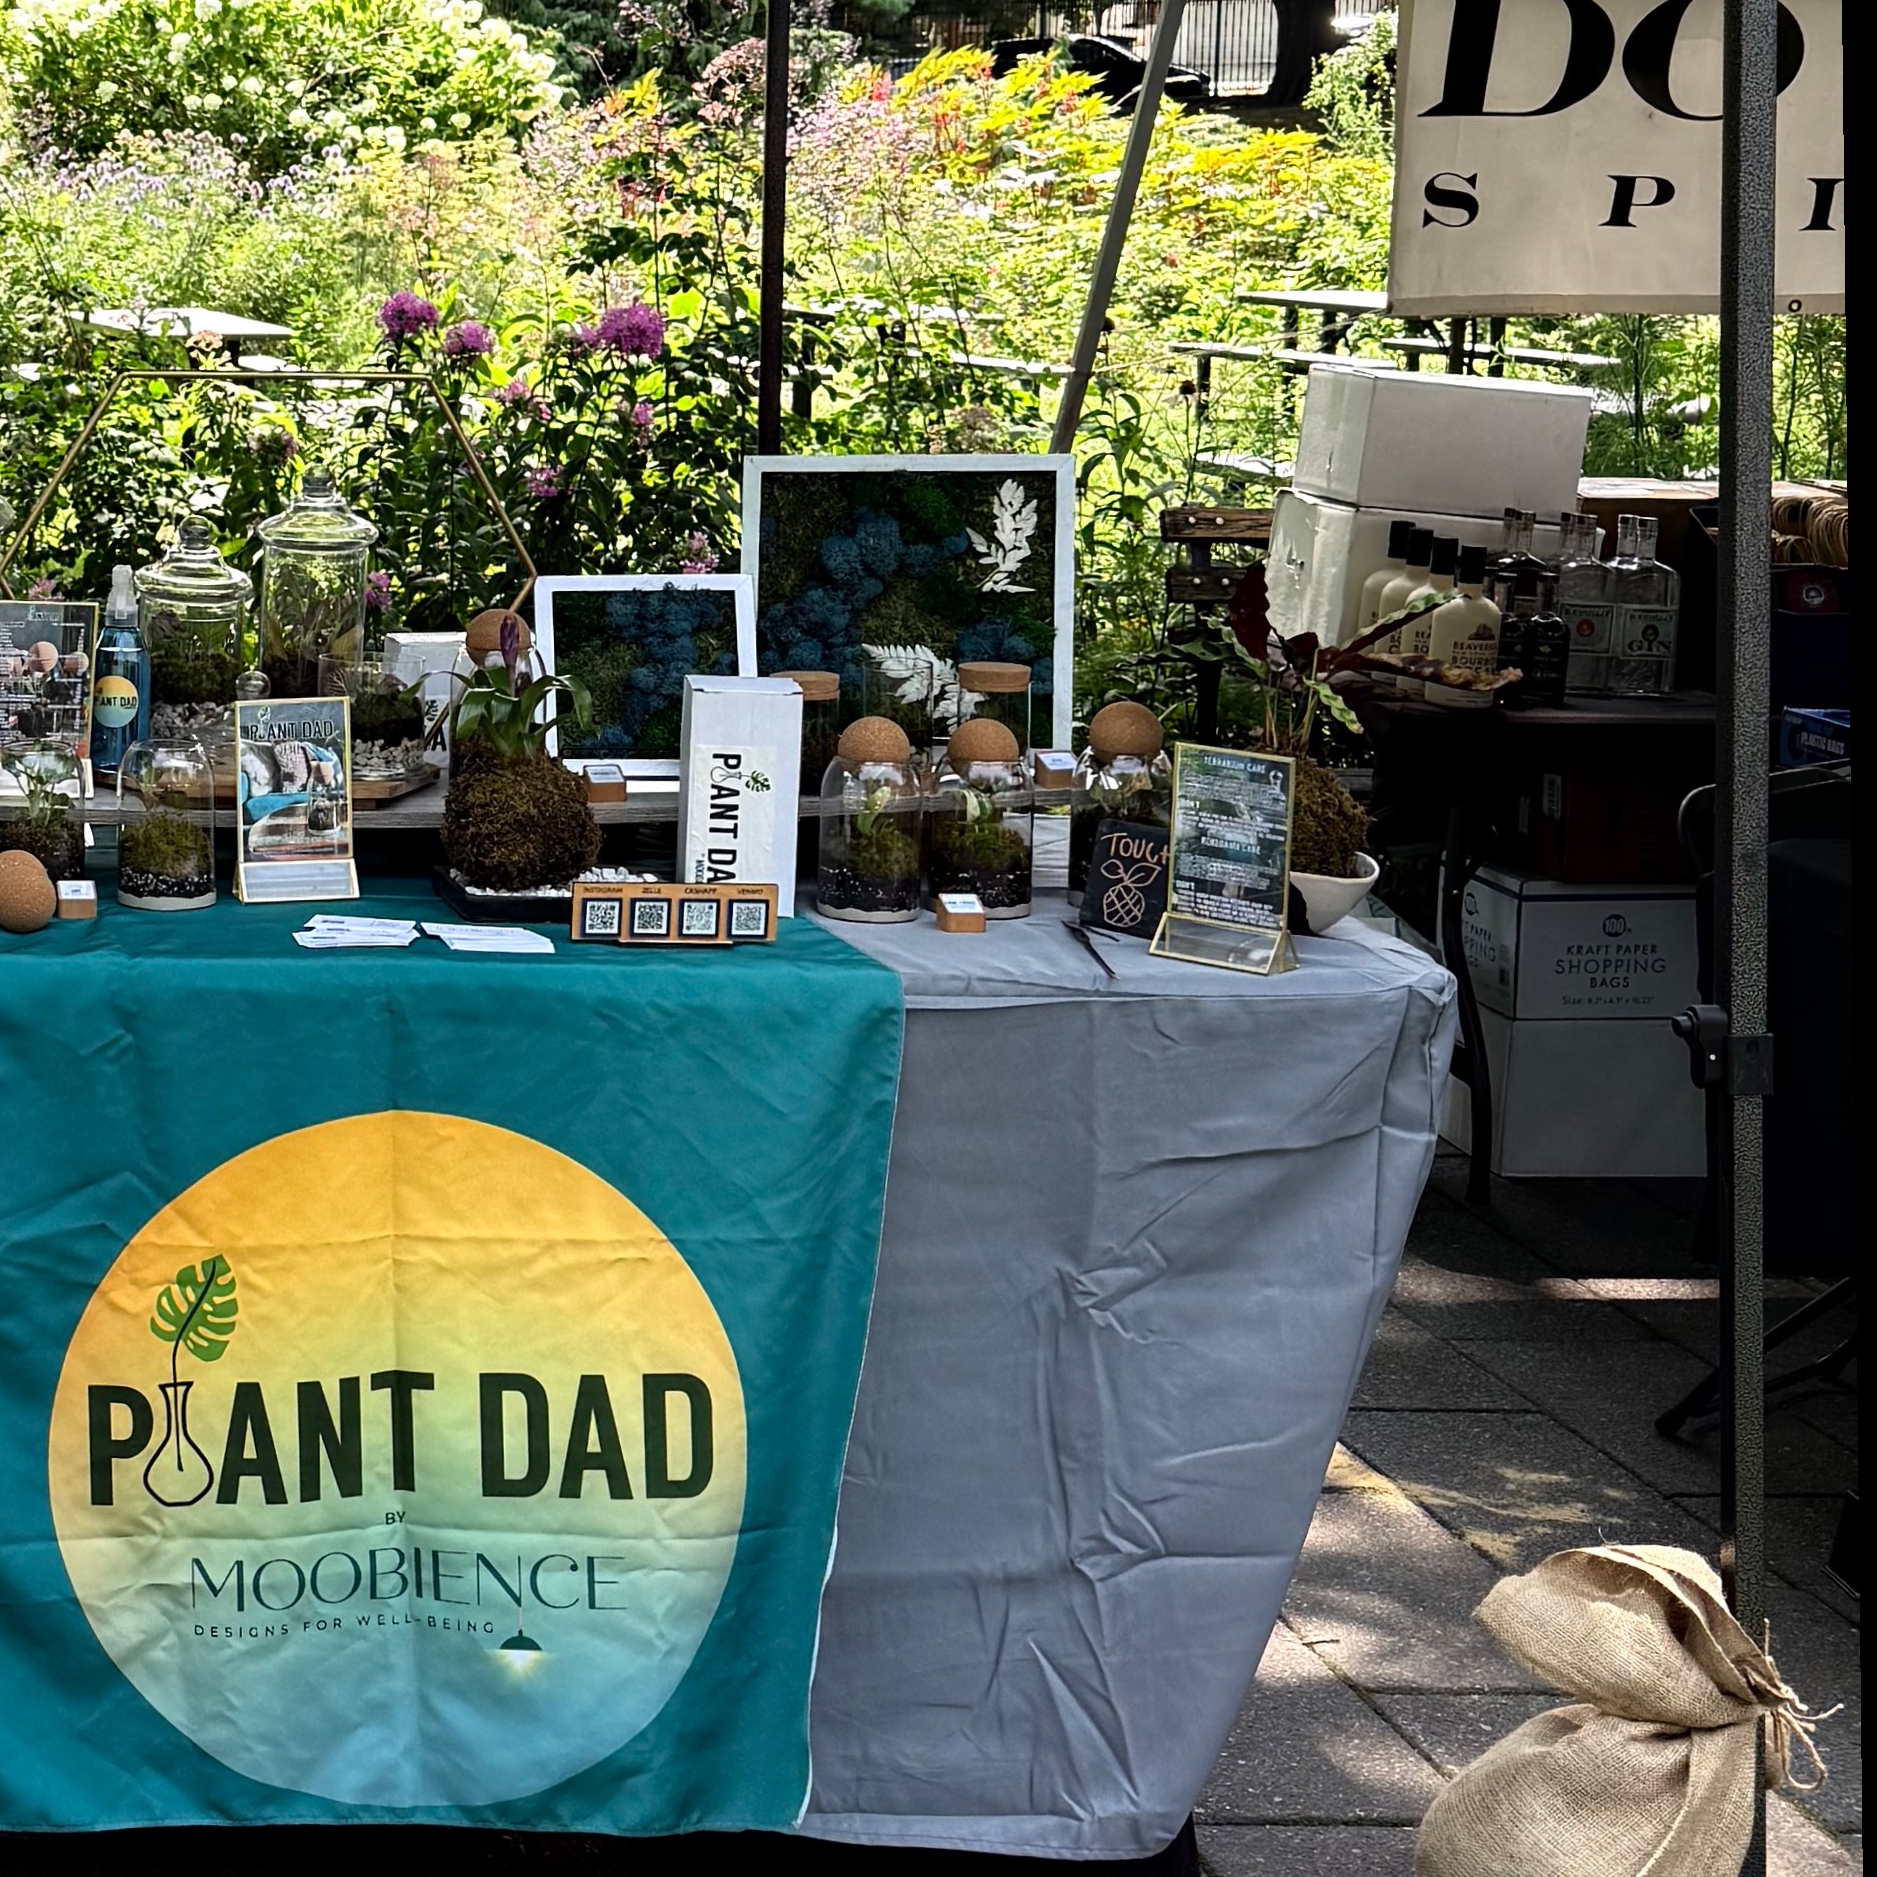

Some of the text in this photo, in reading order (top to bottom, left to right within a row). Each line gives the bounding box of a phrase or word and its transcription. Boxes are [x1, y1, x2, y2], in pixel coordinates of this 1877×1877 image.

[707, 848, 737, 884] DA
[1566, 943, 1658, 955] KRAFT PAPER
[1554, 958, 1666, 975] SHOPPING
[1589, 976, 1630, 988] BAGS
[479, 1372, 714, 1500] DAD
[385, 1511, 406, 1525] BY
[191, 1546, 627, 1613] MOOBIENCE
[193, 1613, 494, 1638] DESIGNS FOR WELL-BEING
